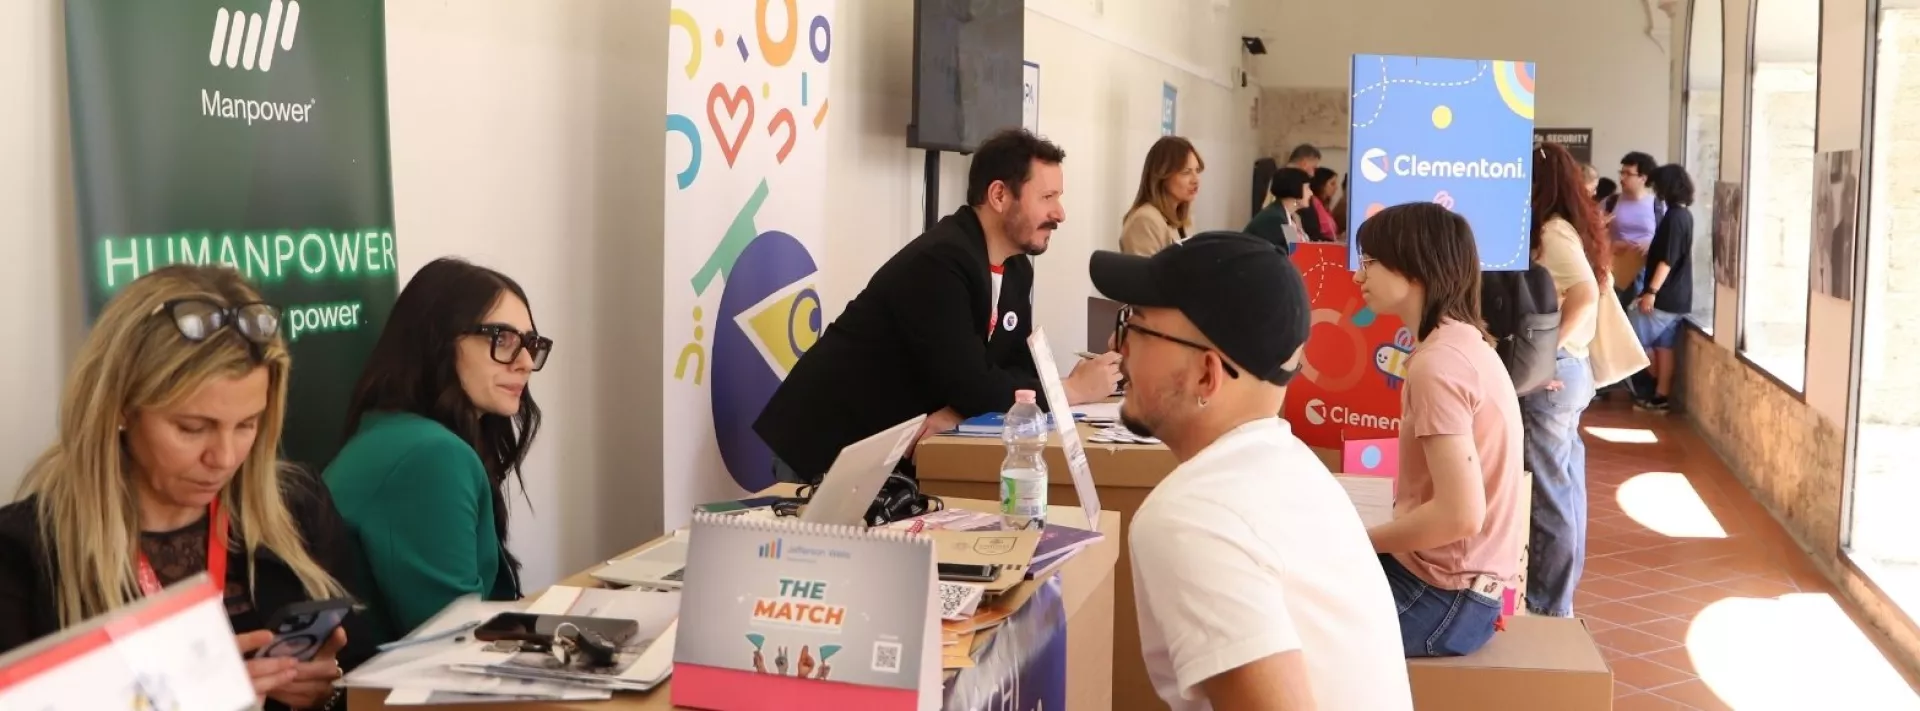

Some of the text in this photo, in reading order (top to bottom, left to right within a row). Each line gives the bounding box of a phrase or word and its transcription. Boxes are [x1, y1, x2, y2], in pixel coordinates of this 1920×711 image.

[201, 88, 312, 126] Manpower
[290, 303, 360, 338] power
[779, 578, 826, 600] THE
[754, 600, 844, 625] MATCH
